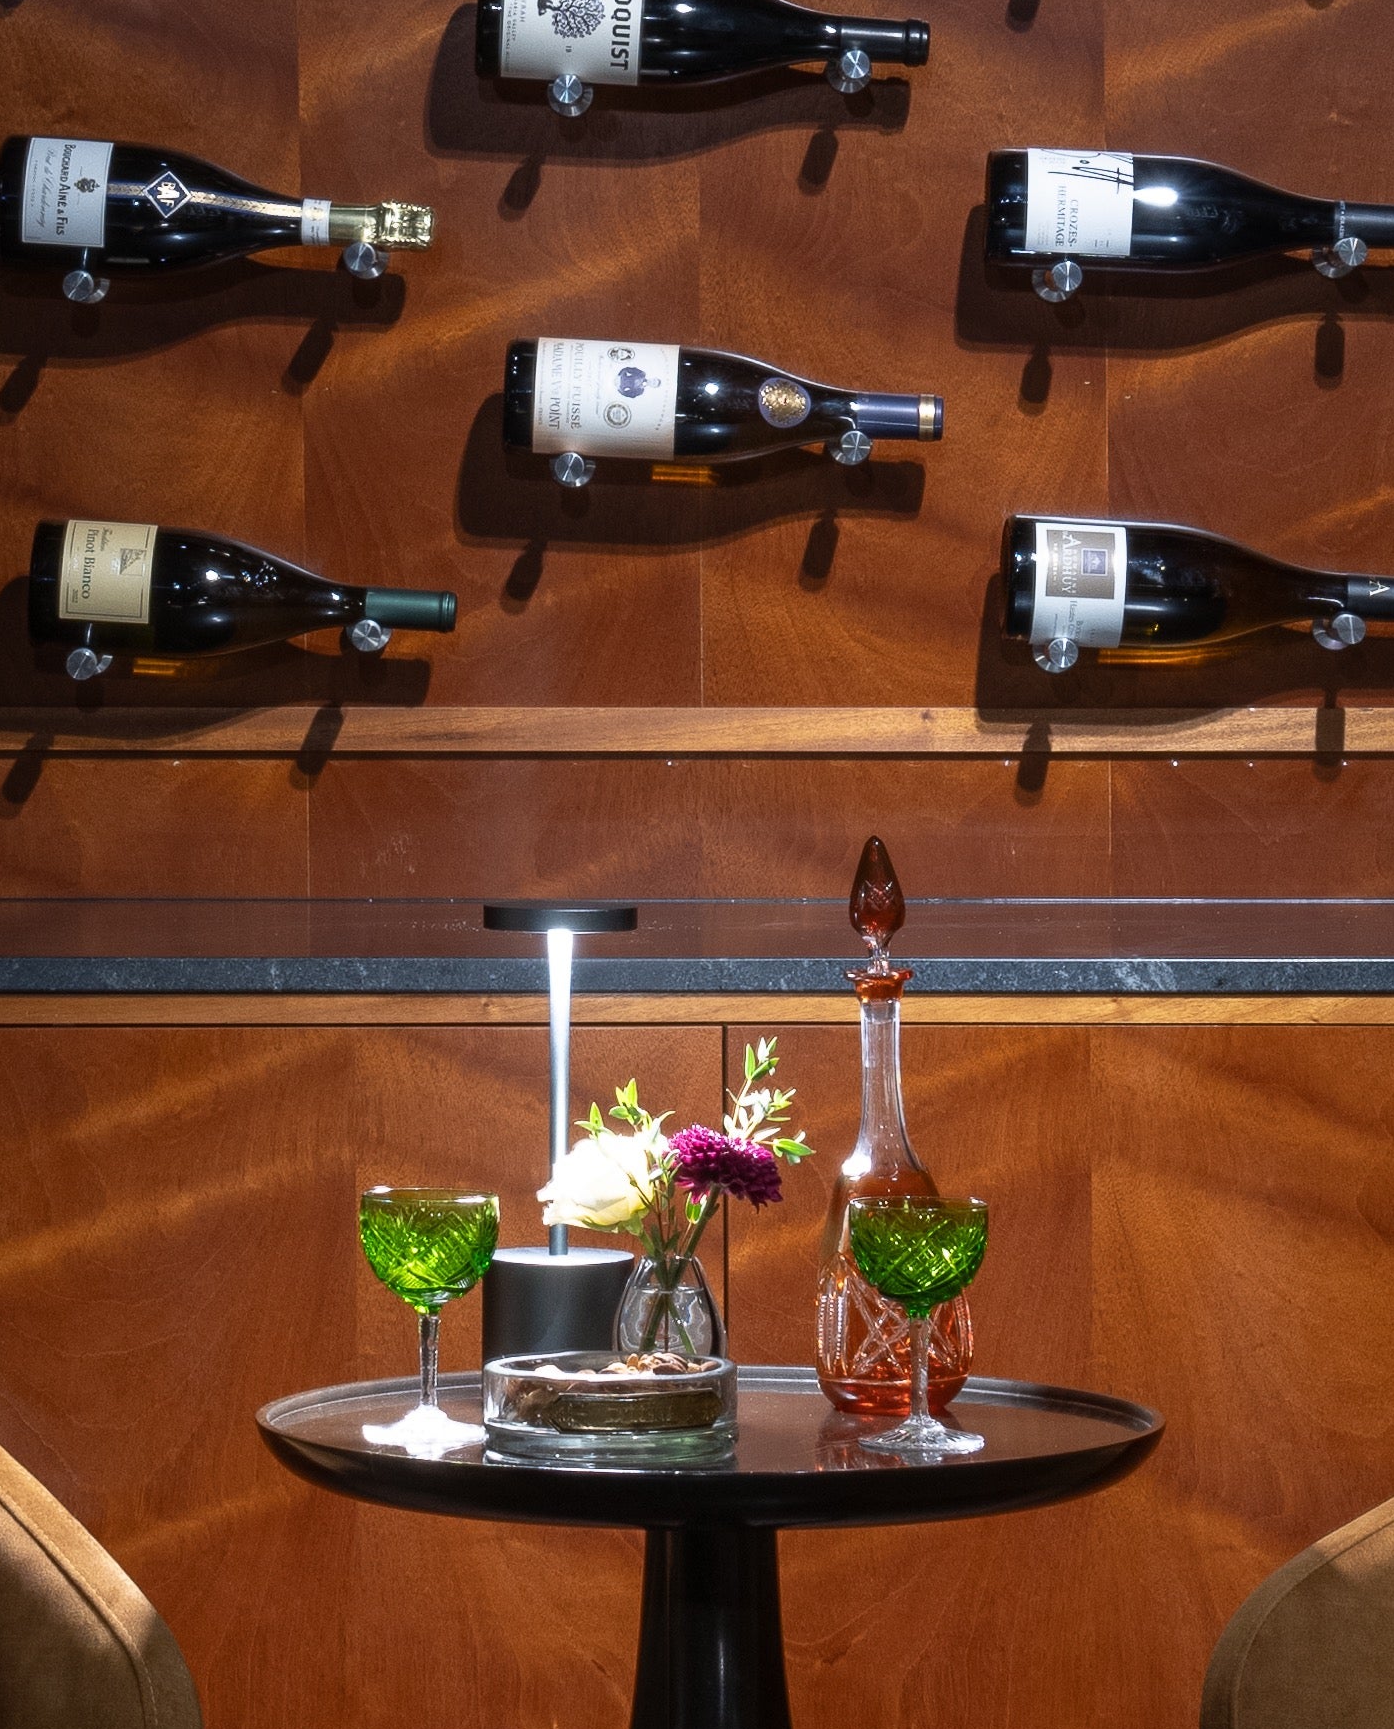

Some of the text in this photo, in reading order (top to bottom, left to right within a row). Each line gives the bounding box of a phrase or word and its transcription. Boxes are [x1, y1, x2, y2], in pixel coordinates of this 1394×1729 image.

[59, 143, 77, 183] BOUCHARD
[156, 181, 181, 208] BAF
[55, 216, 69, 236] FILS
[1055, 184, 1067, 247] HERMITAGE
[81, 528, 100, 600] Pinot Bianco
